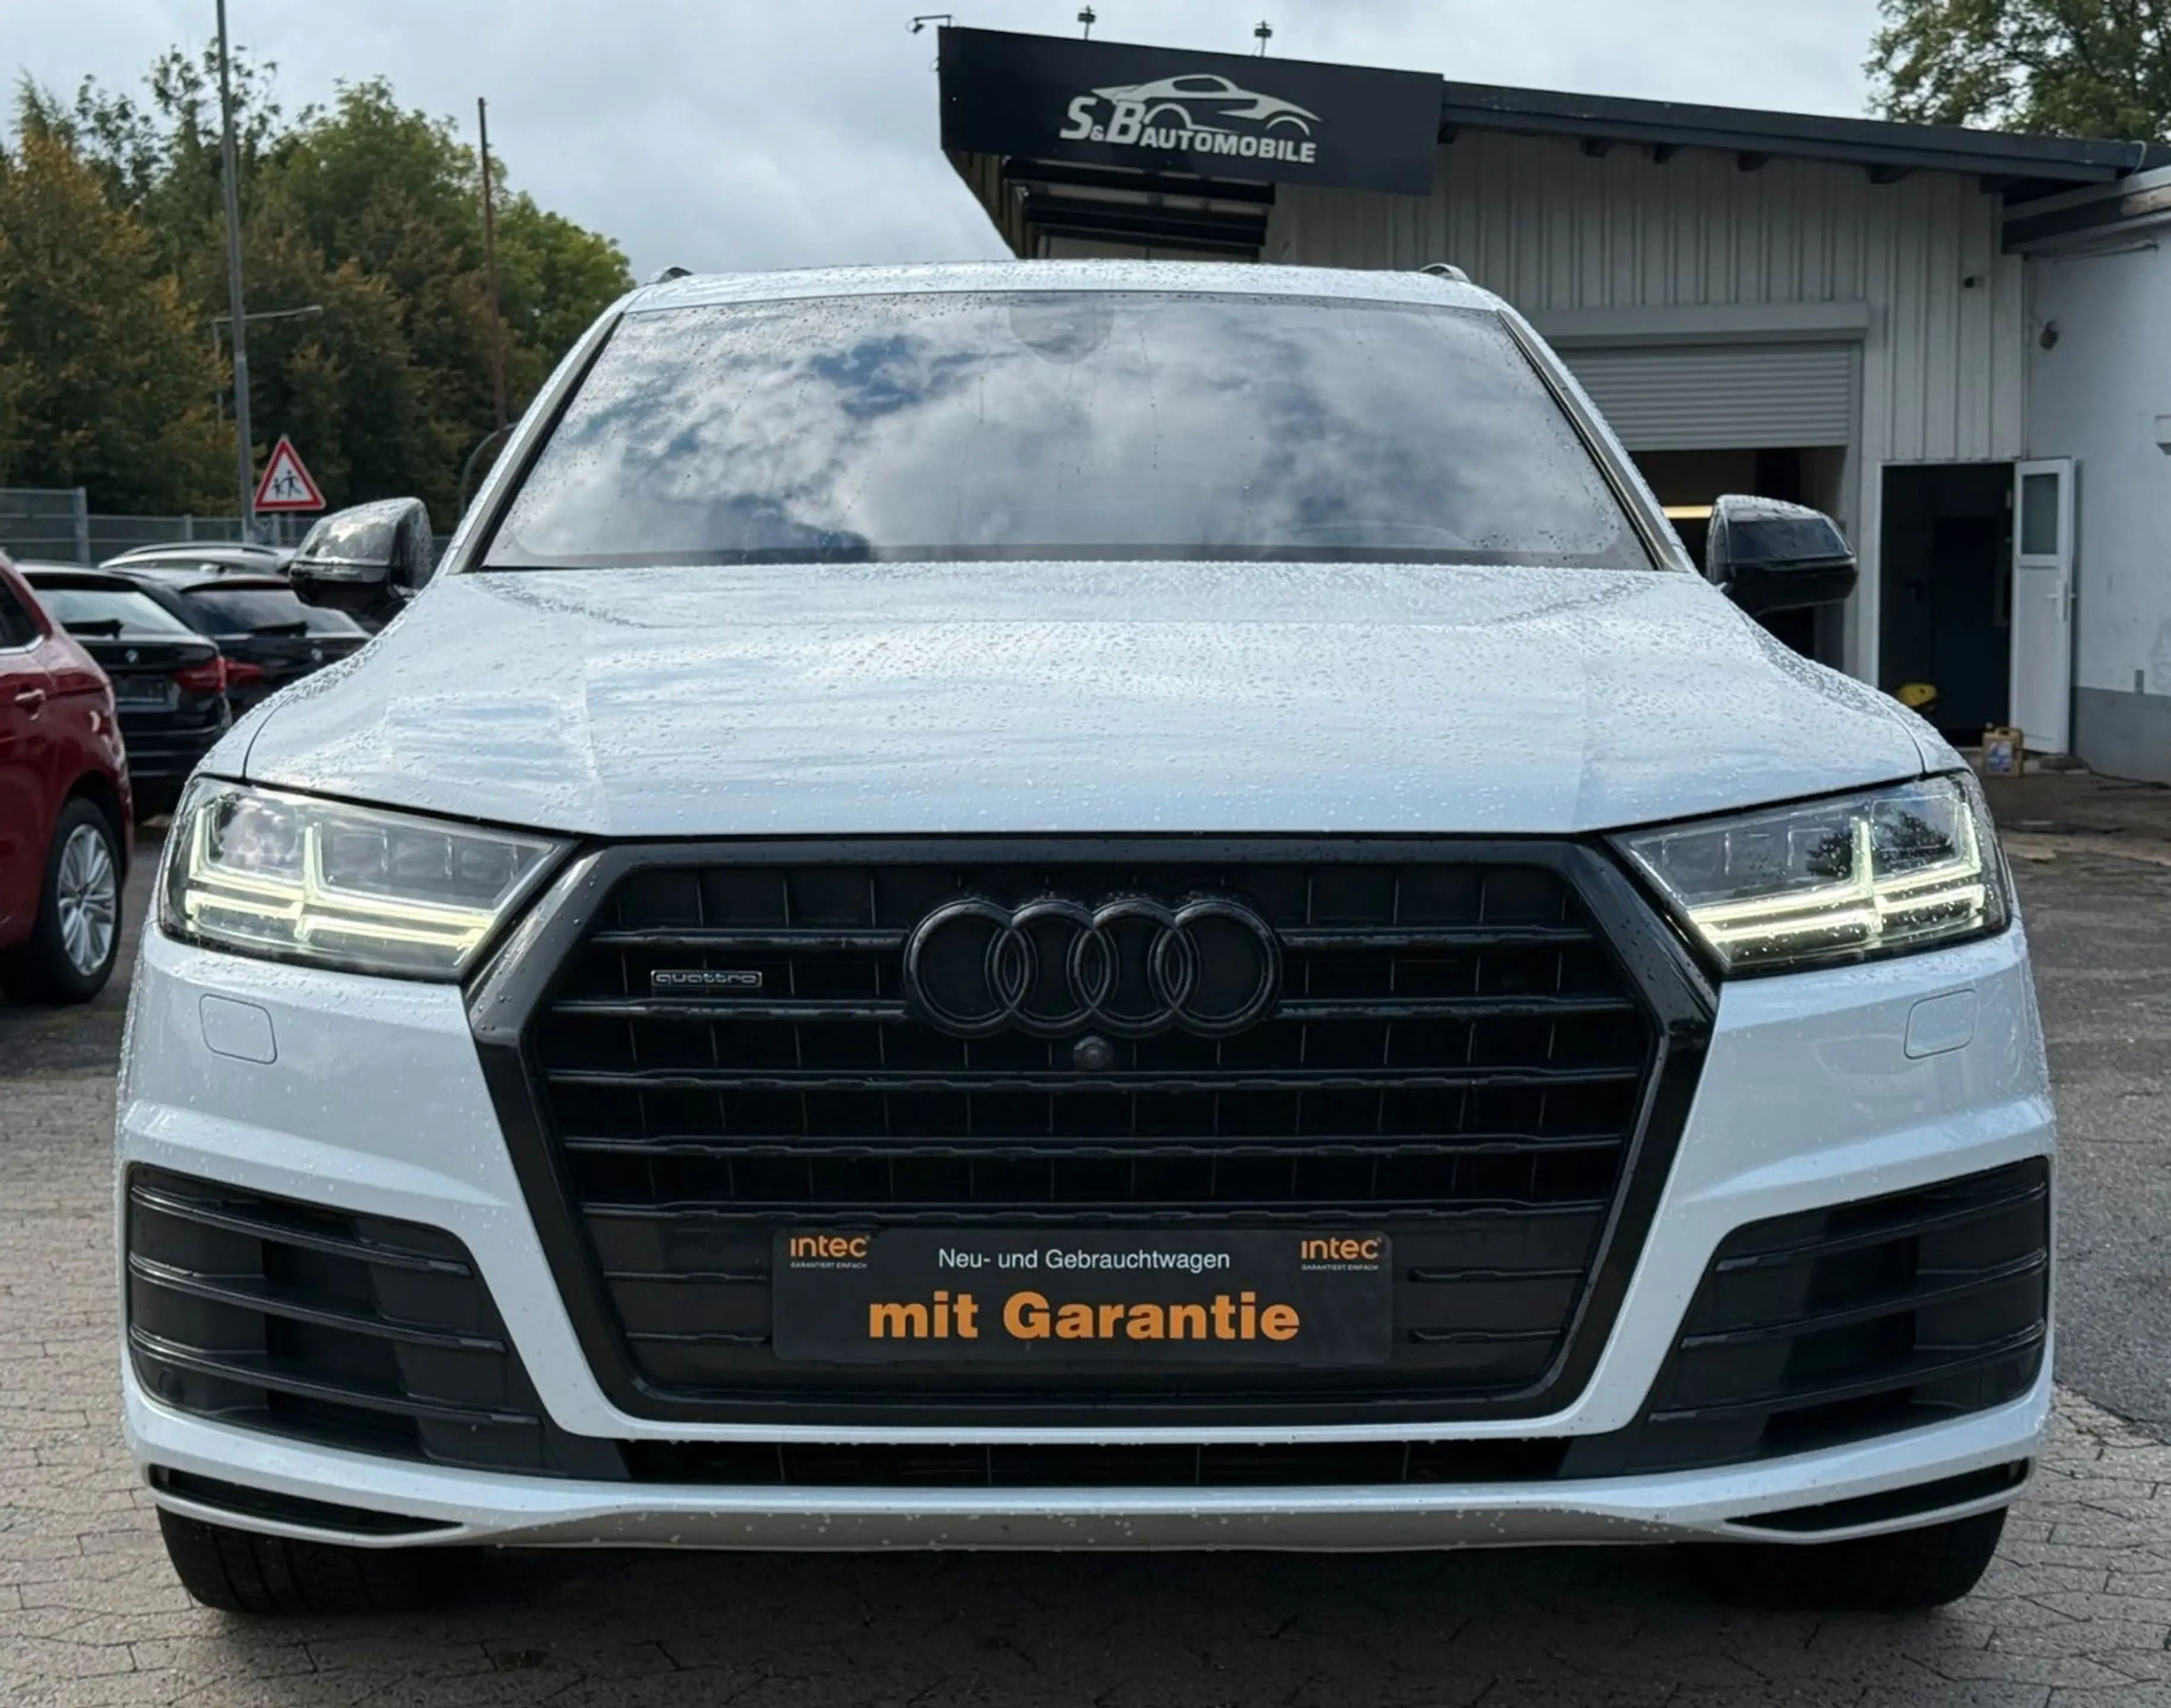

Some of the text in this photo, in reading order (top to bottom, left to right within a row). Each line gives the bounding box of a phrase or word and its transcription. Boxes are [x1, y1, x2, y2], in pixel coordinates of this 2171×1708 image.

[1059, 95, 1317, 163] S&B AUTOMOBILE
[655, 973, 757, 985] quattro
[790, 1235, 867, 1258] intec
[1301, 1237, 1379, 1260] intec
[939, 1248, 1230, 1274] Neu- und Gebrauchtwagen
[868, 1290, 1300, 1341] mit Garantie
